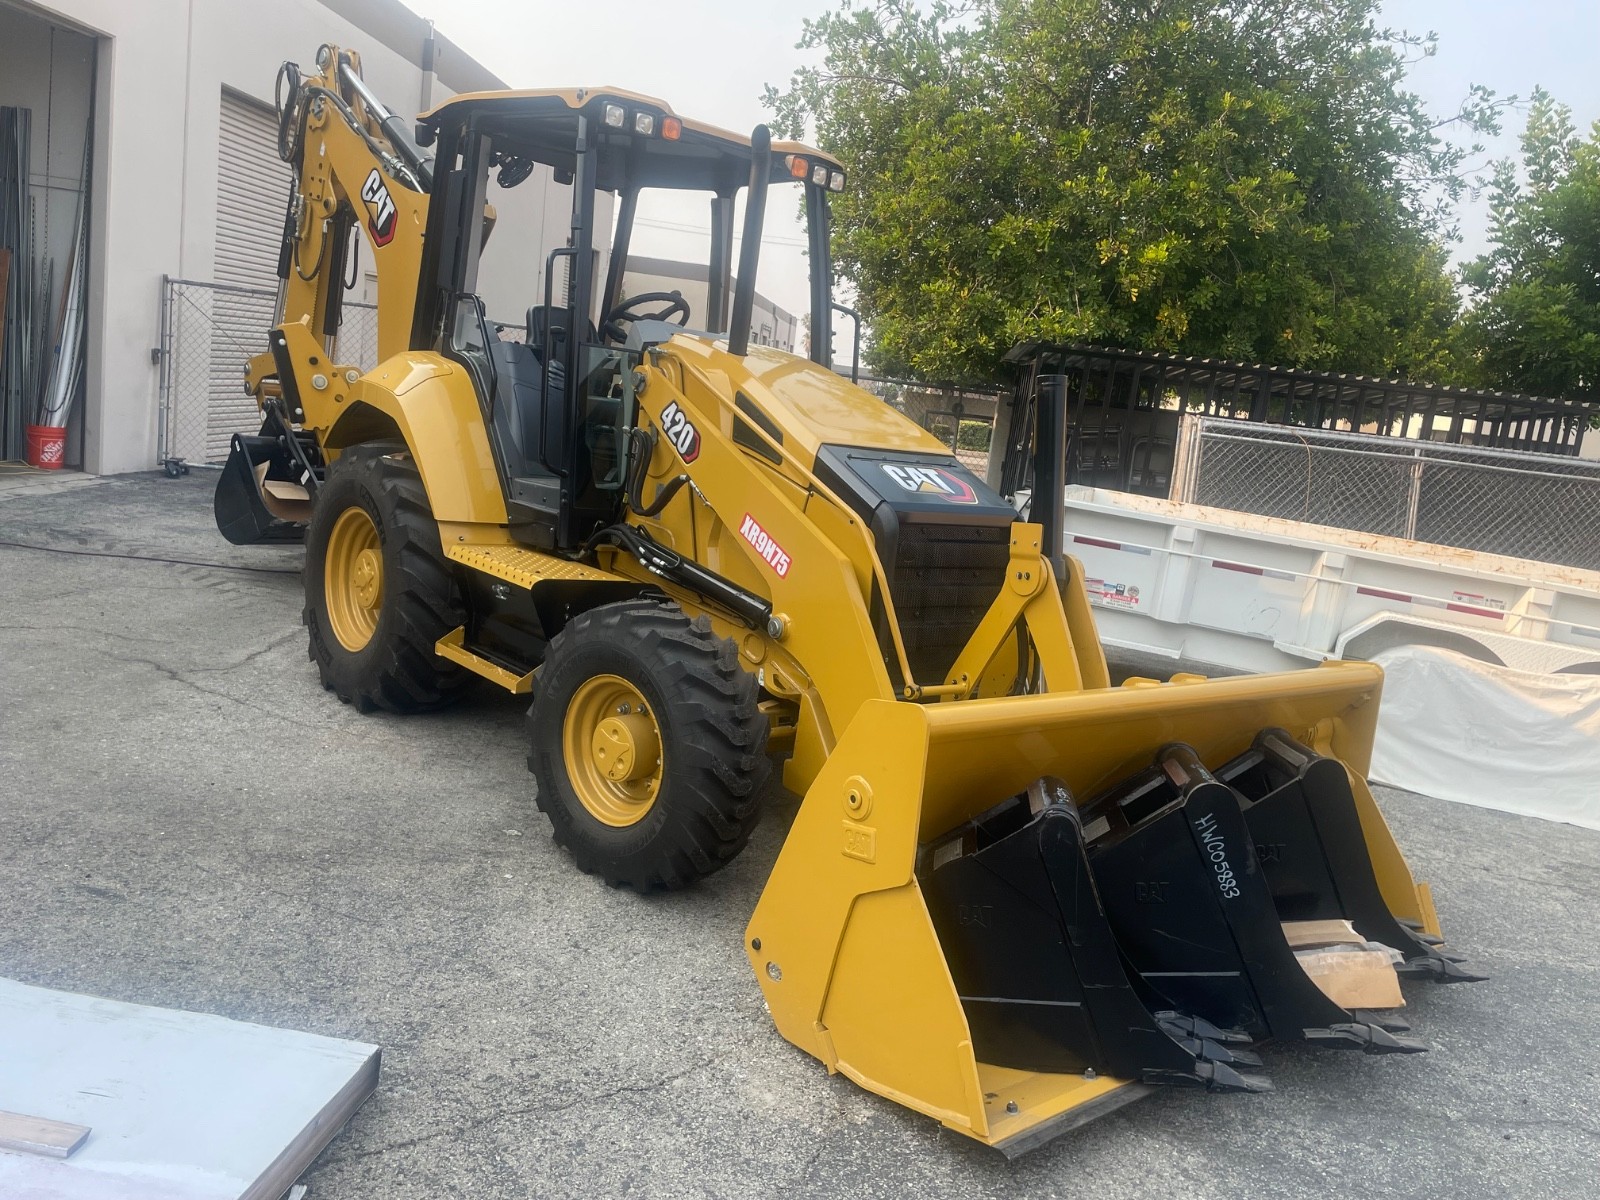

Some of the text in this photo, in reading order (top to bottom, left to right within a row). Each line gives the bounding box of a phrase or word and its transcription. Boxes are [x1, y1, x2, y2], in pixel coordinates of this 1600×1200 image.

[361, 169, 396, 230] CAT
[661, 401, 695, 454] 420
[41, 440, 63, 462] HOME
[882, 464, 956, 494] CAT
[739, 513, 792, 577] XR9H75
[844, 829, 871, 857] CAT
[1255, 844, 1287, 862] CAT
[1135, 881, 1170, 904] CAT
[958, 904, 993, 928] CAT
